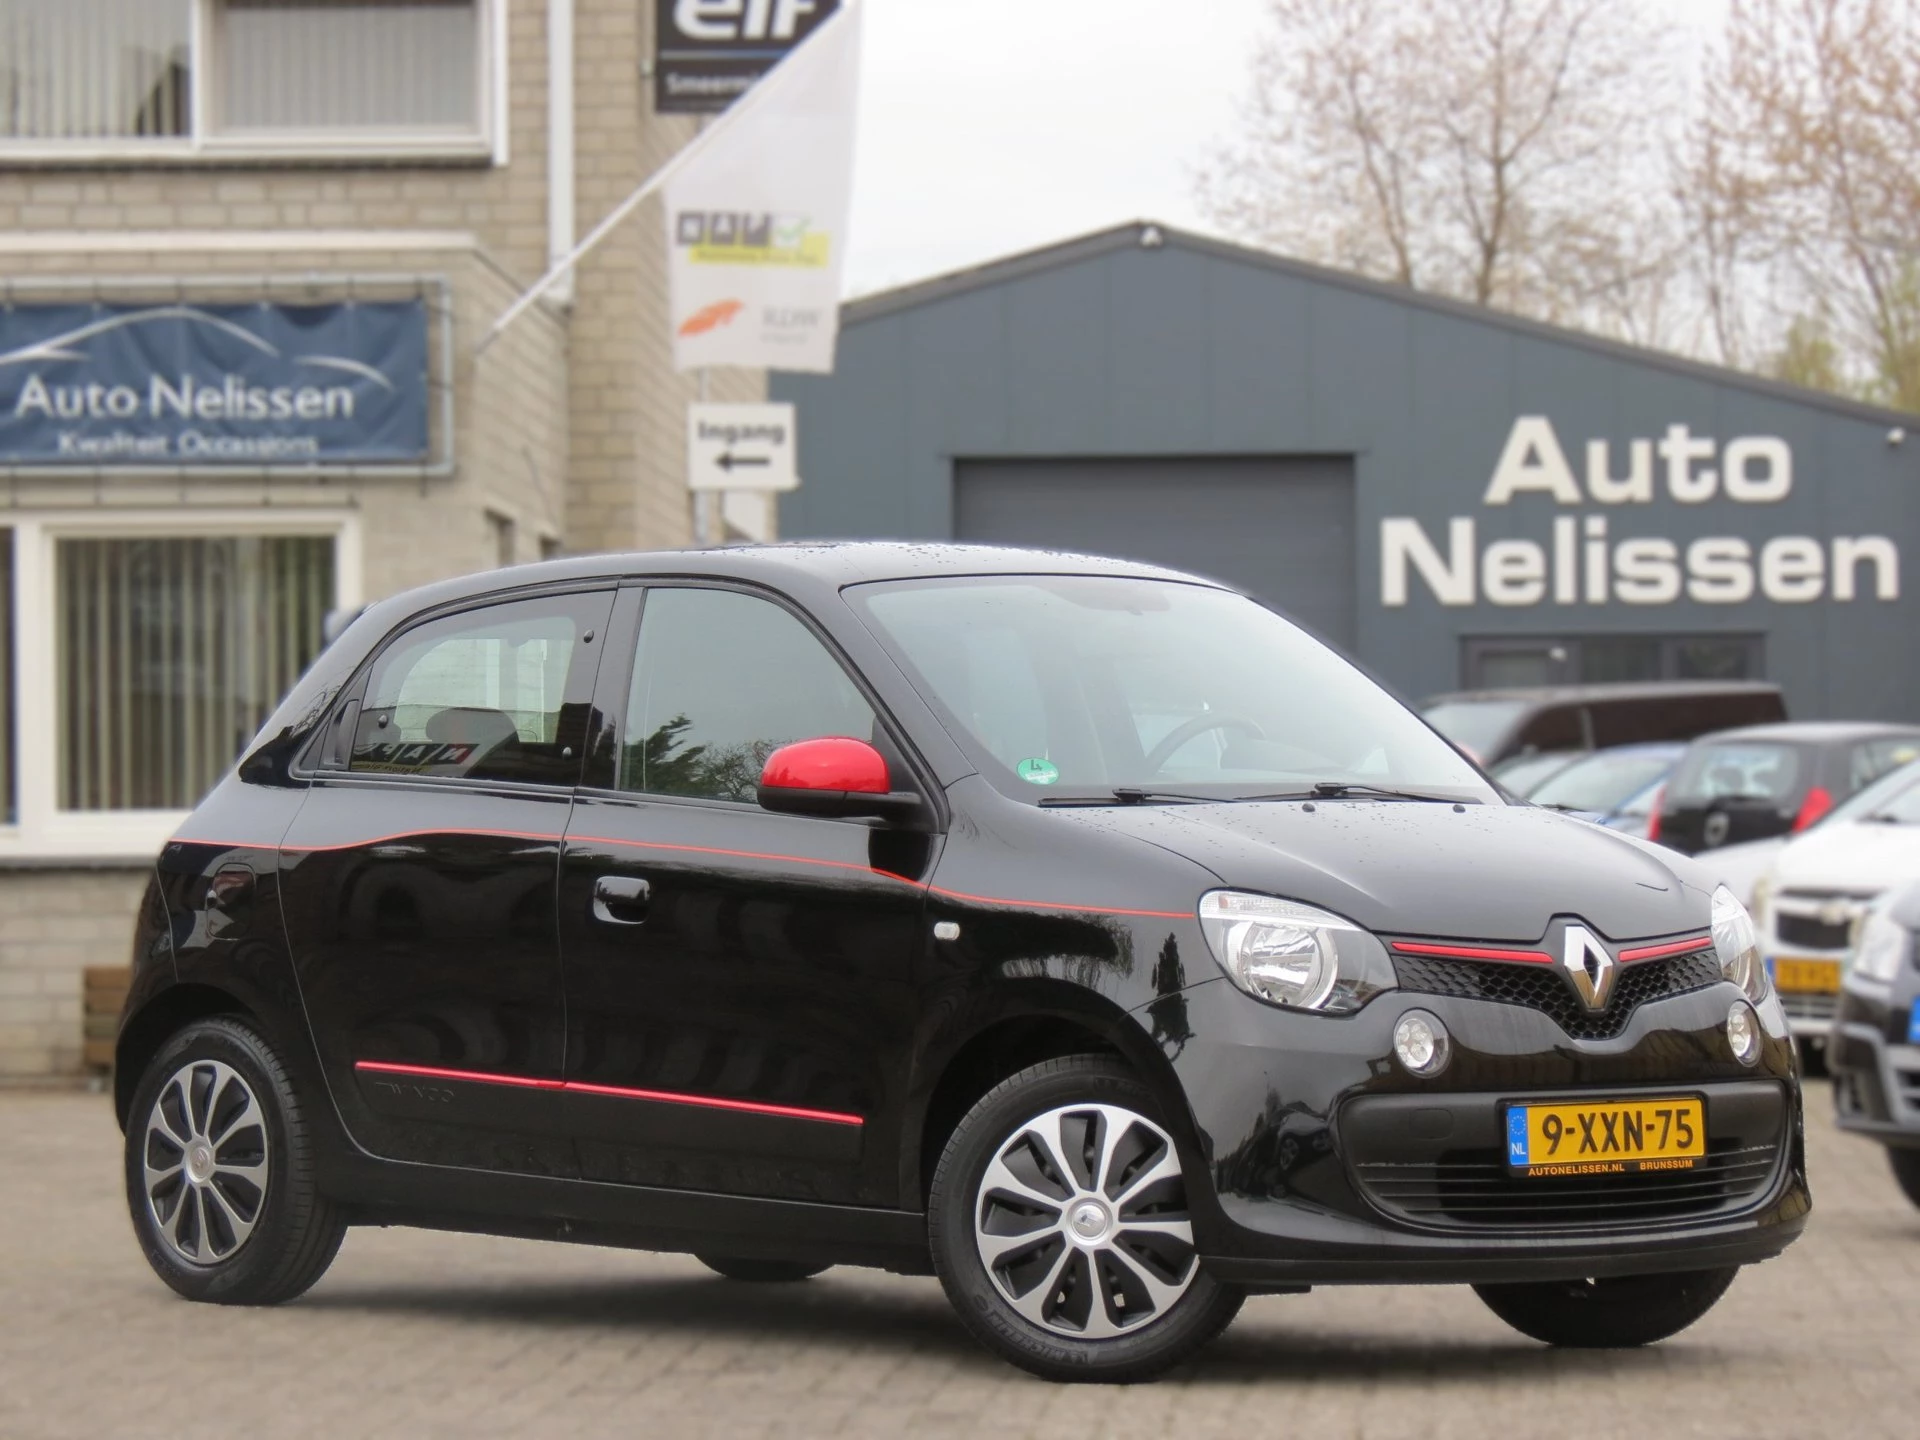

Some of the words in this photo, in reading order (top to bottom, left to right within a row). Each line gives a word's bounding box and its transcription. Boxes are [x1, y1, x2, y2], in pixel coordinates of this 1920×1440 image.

[14, 373, 139, 419] Auto
[150, 373, 355, 420] Nelissen
[698, 421, 785, 446] Ingang
[1482, 415, 1793, 505] Auto
[1380, 516, 1899, 606] Nelissen
[1511, 1142, 1526, 1156] NL
[1541, 1109, 1694, 1156] 9-XXN-75
[1528, 1162, 1625, 1176] AUTONELISSEN.NL
[1639, 1159, 1693, 1171] BRUNSSUM
